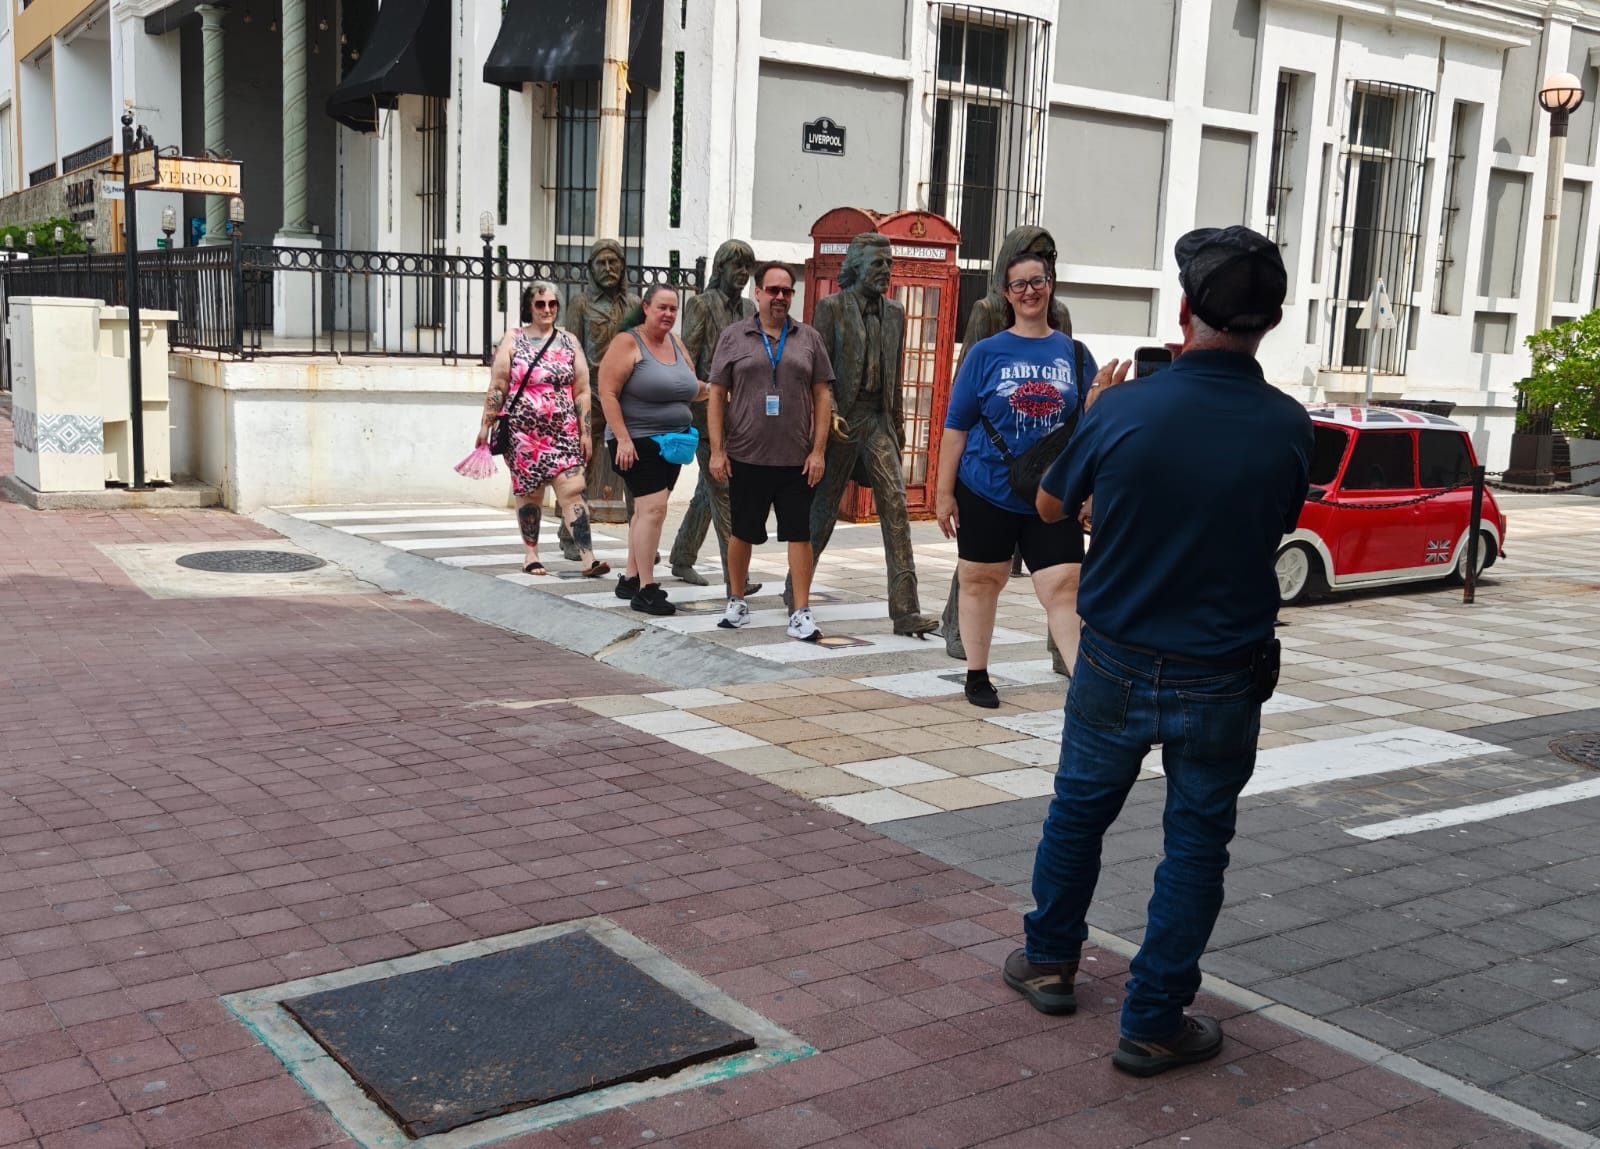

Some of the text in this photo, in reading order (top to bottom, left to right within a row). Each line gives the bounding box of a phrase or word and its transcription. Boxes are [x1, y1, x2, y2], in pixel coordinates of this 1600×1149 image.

[808, 133, 842, 147] LIVERPOOL
[158, 170, 238, 188] VERPOOL
[822, 243, 848, 253] TELEP
[894, 247, 945, 258] ELEPHONE
[1001, 366, 1073, 384] BABY GIRL
